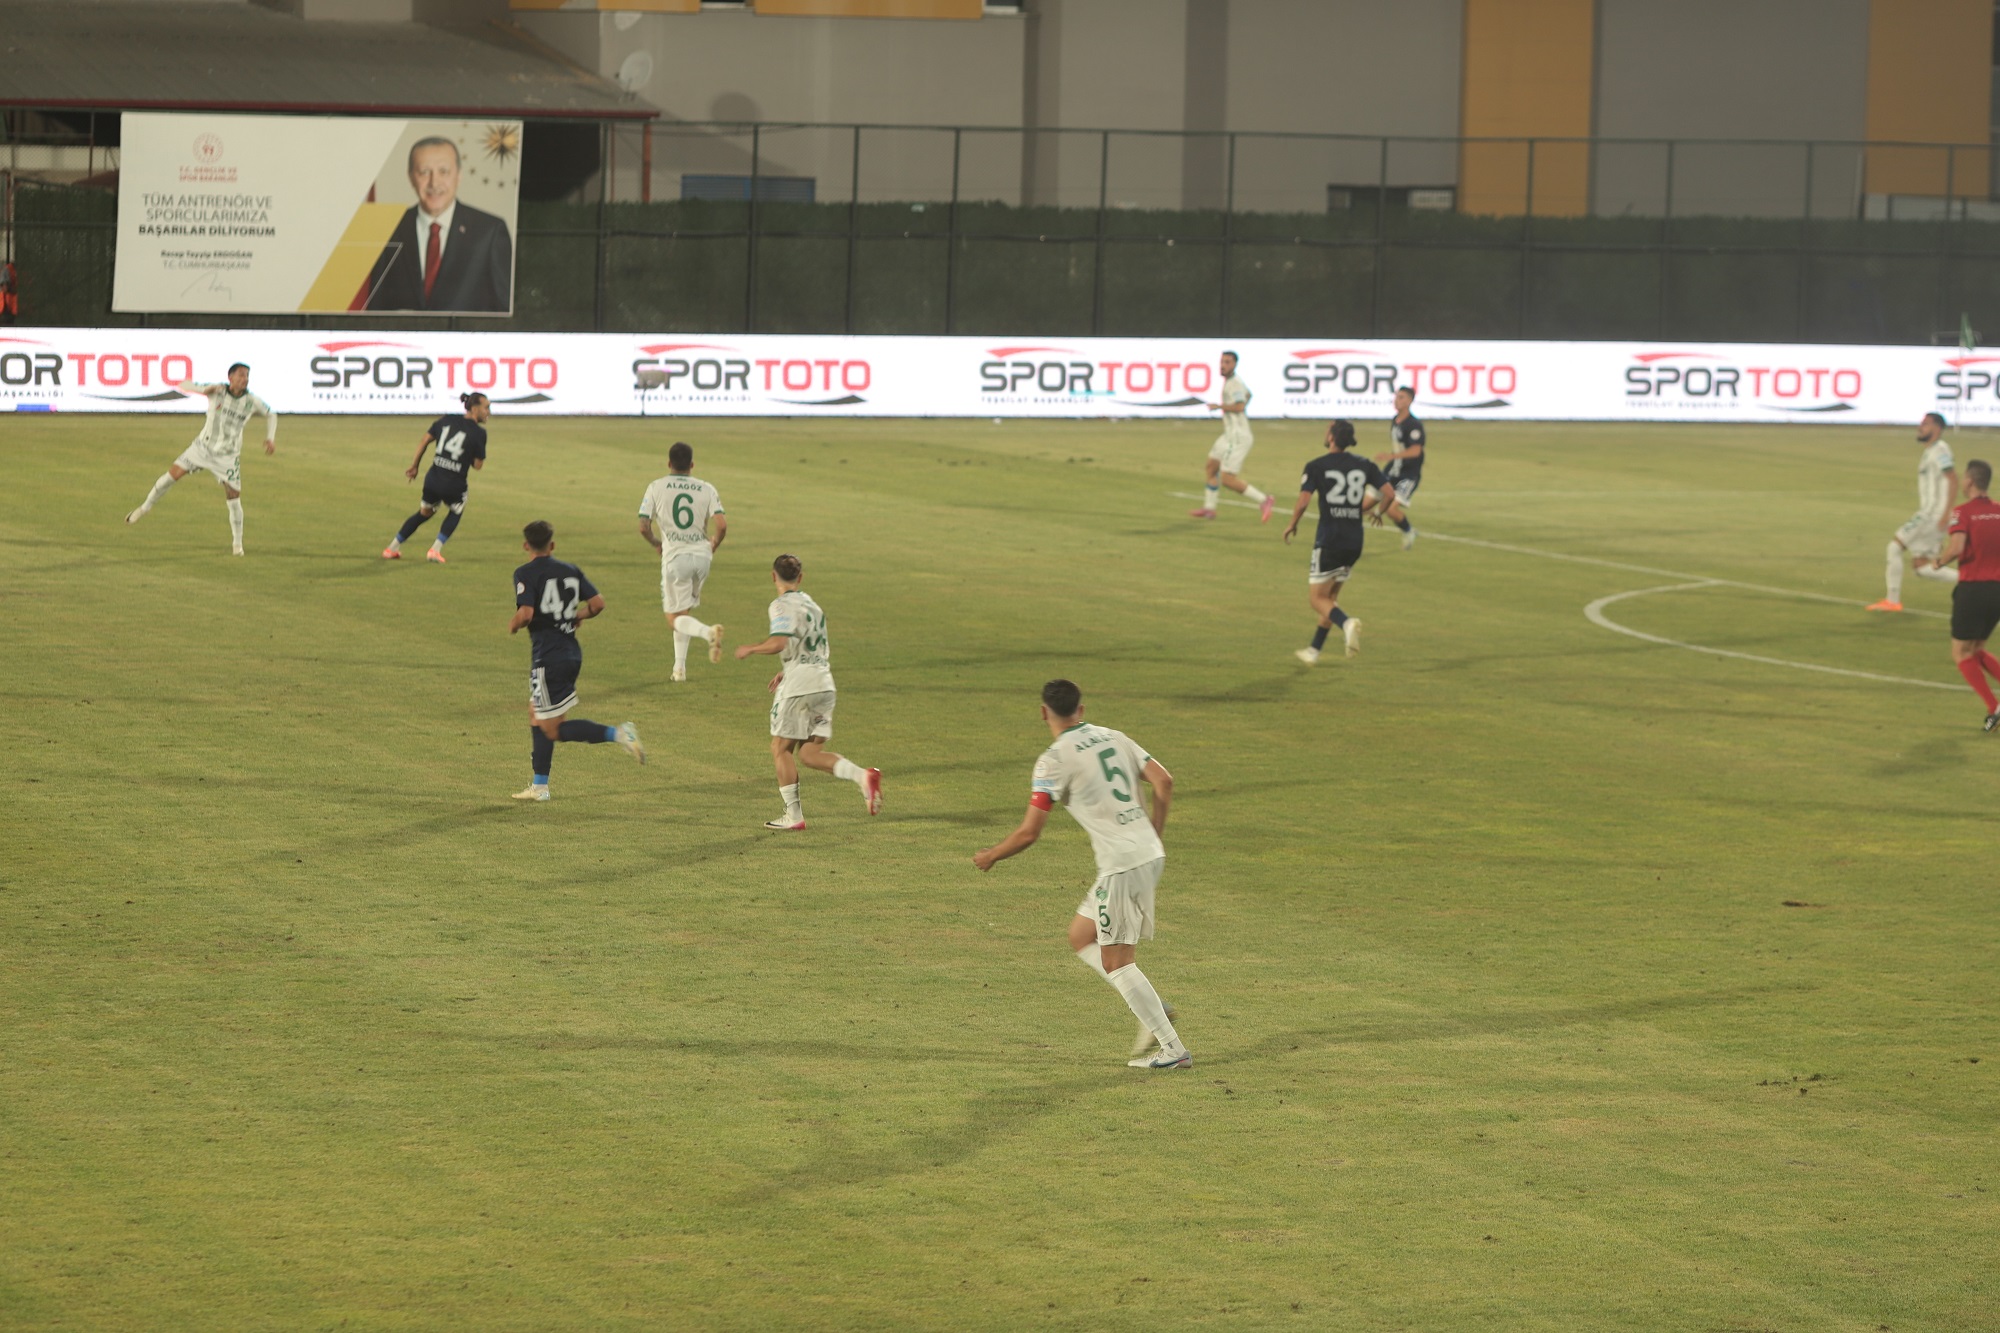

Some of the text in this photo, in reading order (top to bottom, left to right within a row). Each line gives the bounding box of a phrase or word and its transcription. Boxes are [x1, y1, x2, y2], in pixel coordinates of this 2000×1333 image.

[142, 192, 273, 209] TÜM ANTRENÖR VE
[146, 207, 269, 224] SPORCULARIMIZA
[138, 223, 276, 239] BAŞARILAR DİLİYORUM
[67, 353, 193, 387] TOTO
[310, 356, 558, 389] SPOR TOTO
[755, 360, 871, 391] TOTO
[980, 362, 1212, 393] SPOR TOTO
[1284, 364, 1516, 395] SPOR TOTO
[1626, 367, 1861, 398] SPOR TOTO
[1936, 372, 2000, 400] SP
[435, 425, 467, 462] 14
[1324, 469, 1366, 505] 28
[672, 493, 694, 530] 6
[540, 577, 580, 620] 42
[1097, 747, 1131, 803] 5
[1097, 904, 1112, 929] 5
